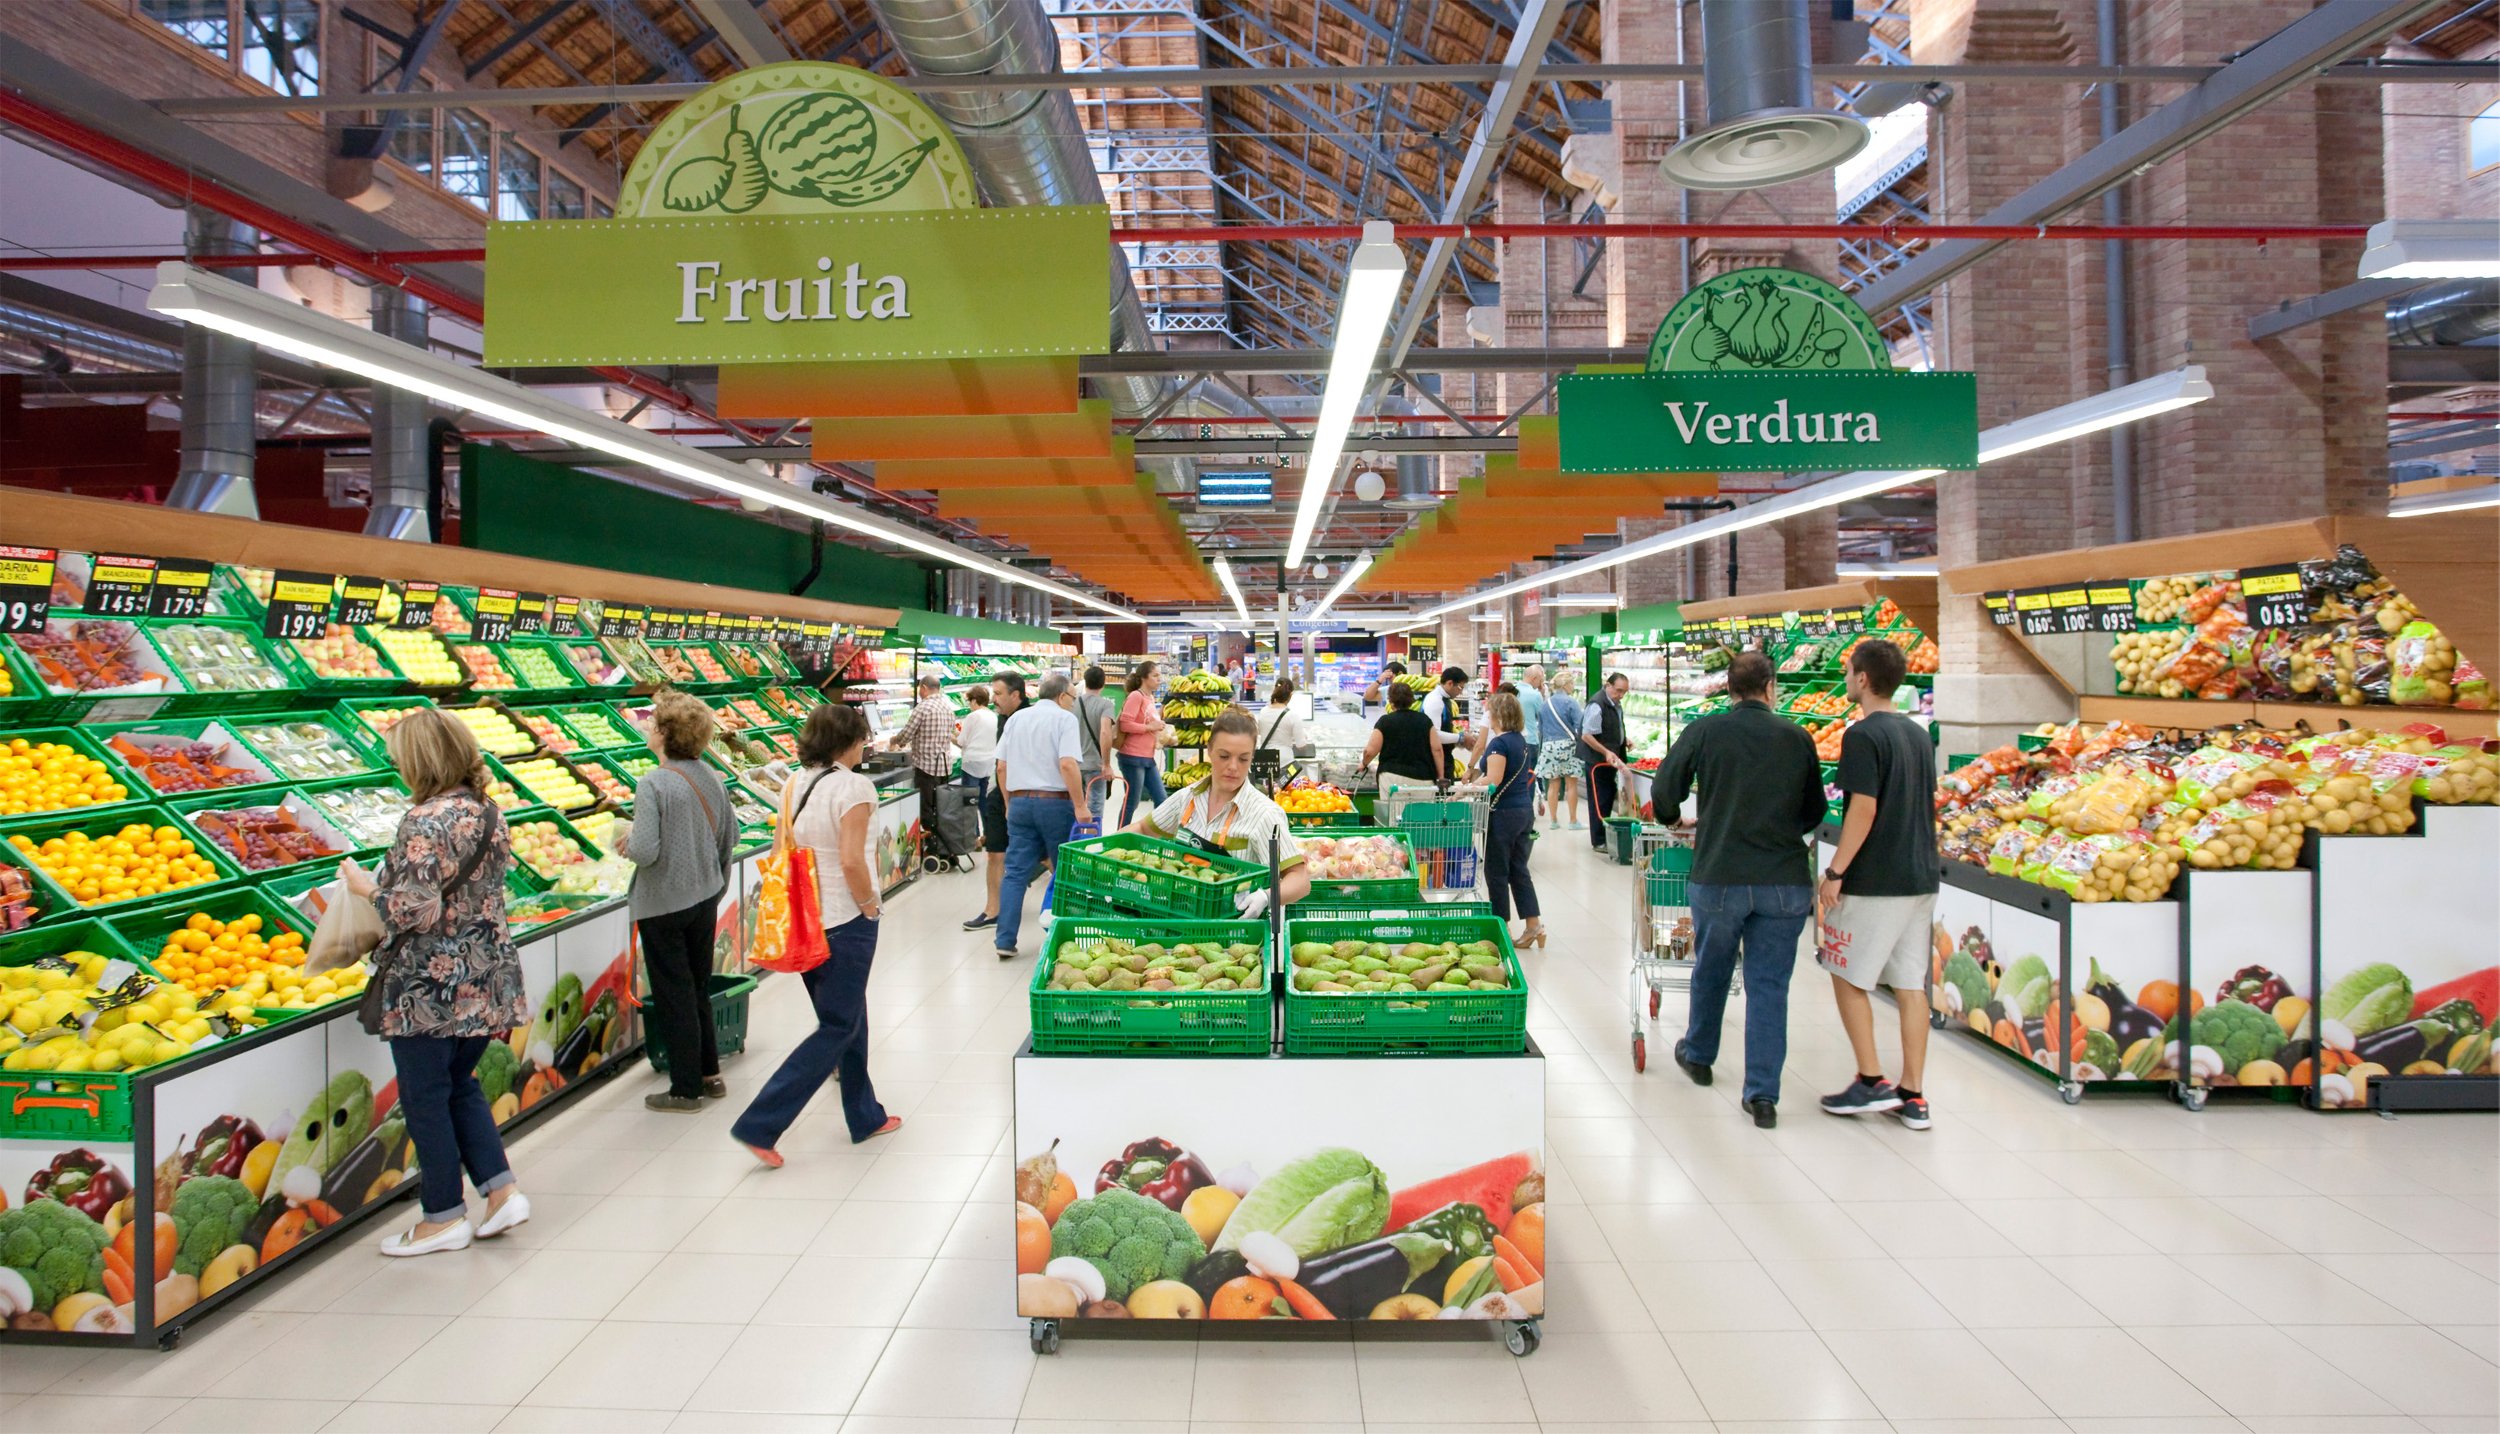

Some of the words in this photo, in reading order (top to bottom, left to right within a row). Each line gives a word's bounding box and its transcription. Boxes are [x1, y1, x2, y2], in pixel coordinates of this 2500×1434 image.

[674, 256, 911, 323] Fruita
[1663, 398, 1881, 444] Verdura
[102, 570, 147, 579] MANDARINA
[2257, 576, 2285, 585] PATATA
[1824, 923, 1852, 943] OLLI
